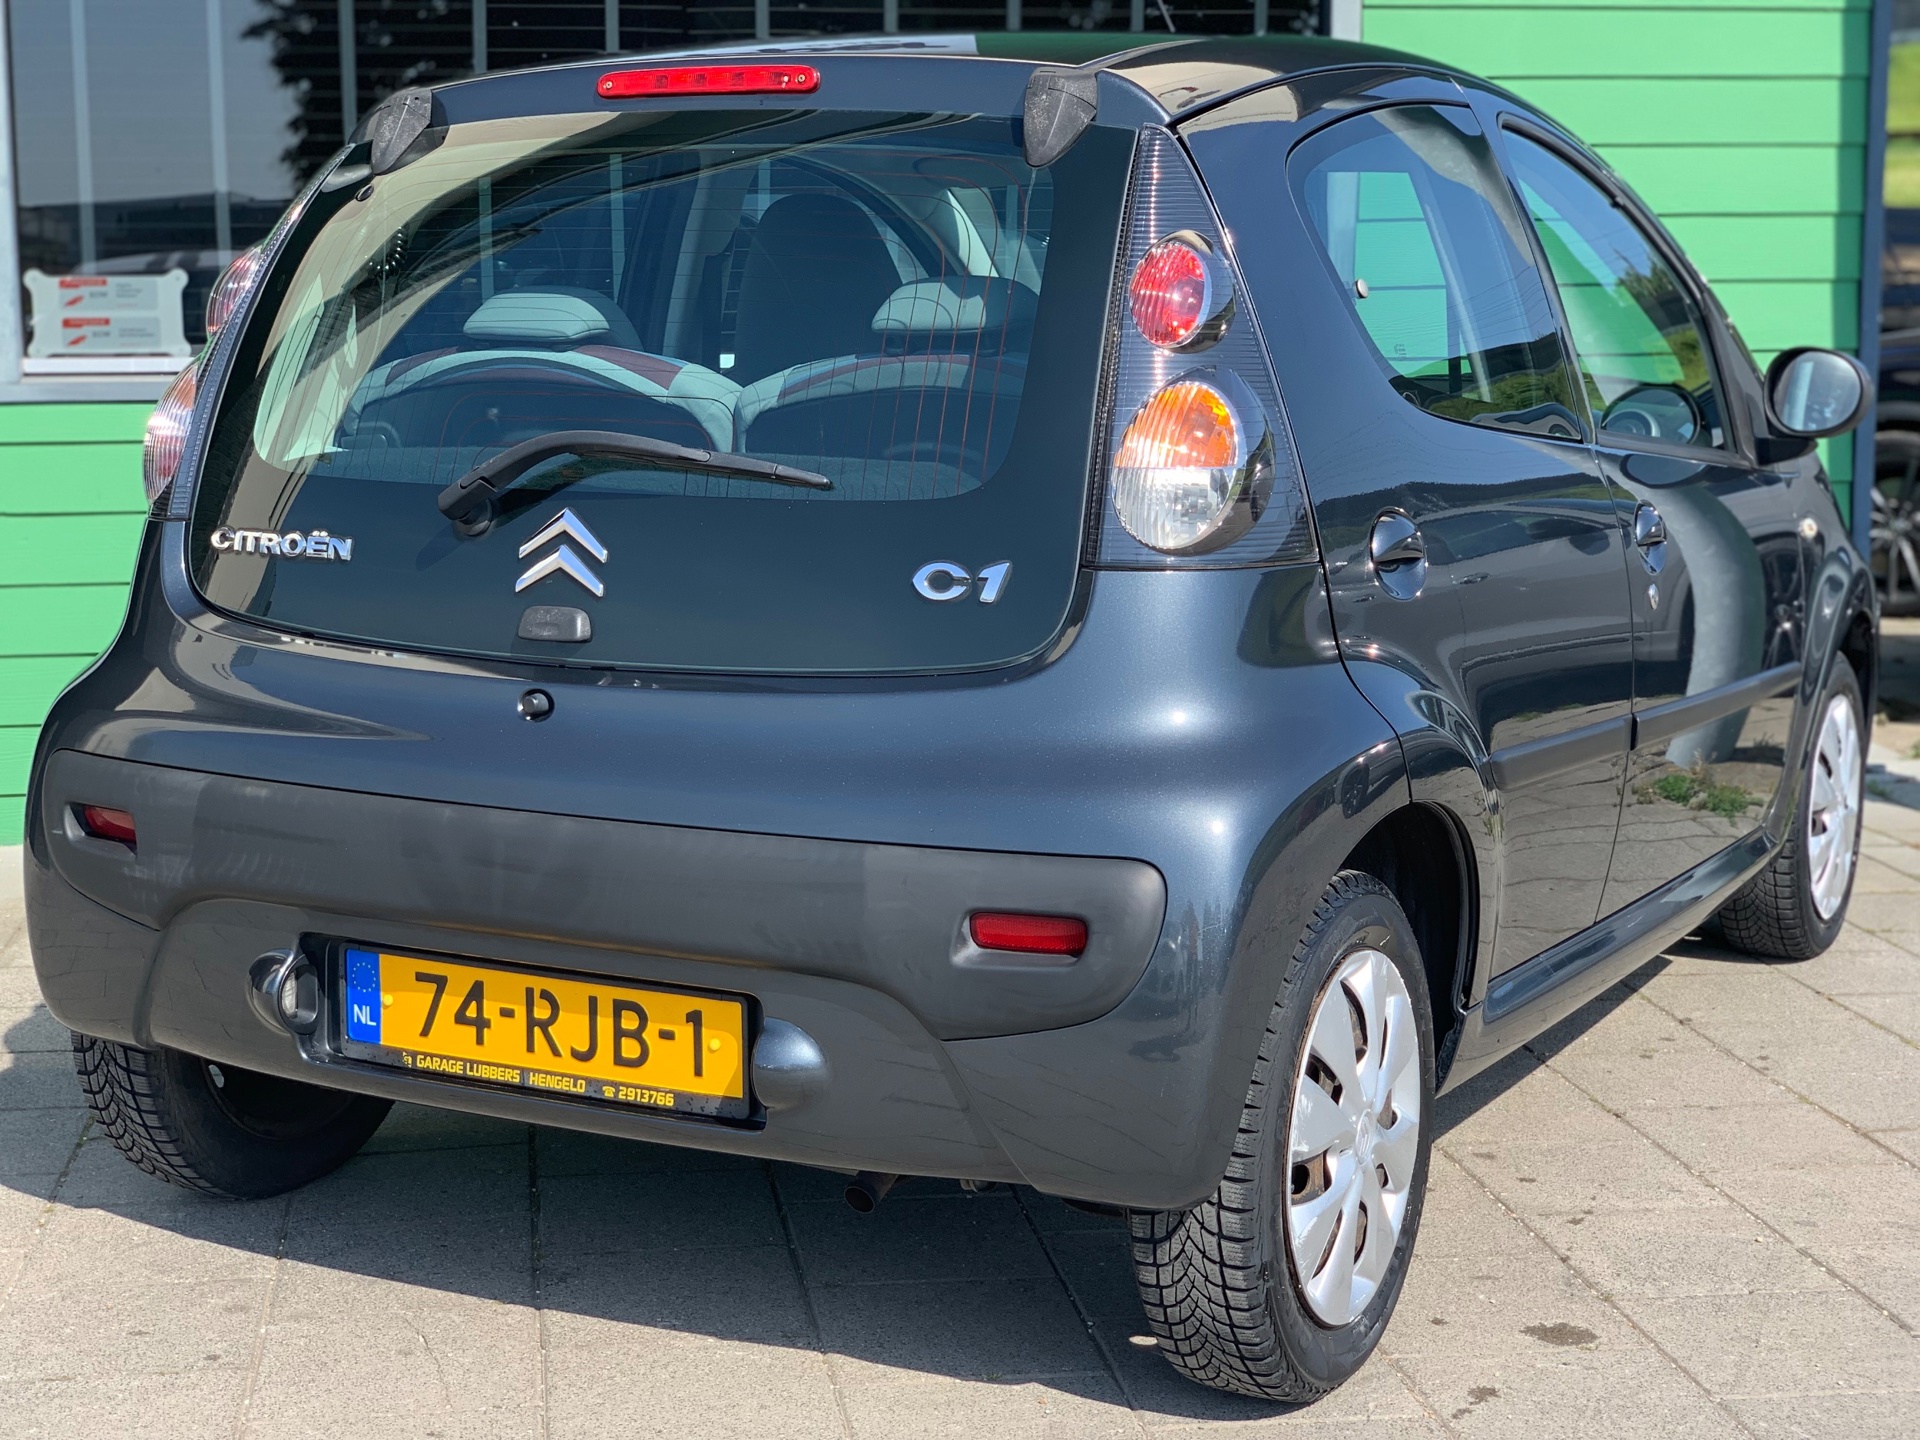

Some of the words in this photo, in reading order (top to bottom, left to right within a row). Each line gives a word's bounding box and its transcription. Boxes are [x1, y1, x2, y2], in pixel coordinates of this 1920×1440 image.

[211, 527, 352, 561] CITROËN
[912, 561, 1010, 603] C1
[353, 1003, 377, 1026] NL
[414, 971, 704, 1077] 74-RJB-1
[416, 1054, 464, 1074] GARAGE
[466, 1062, 520, 1083] LUBBERS
[529, 1071, 586, 1093] HENGELO
[618, 1086, 674, 1107] 2913766
